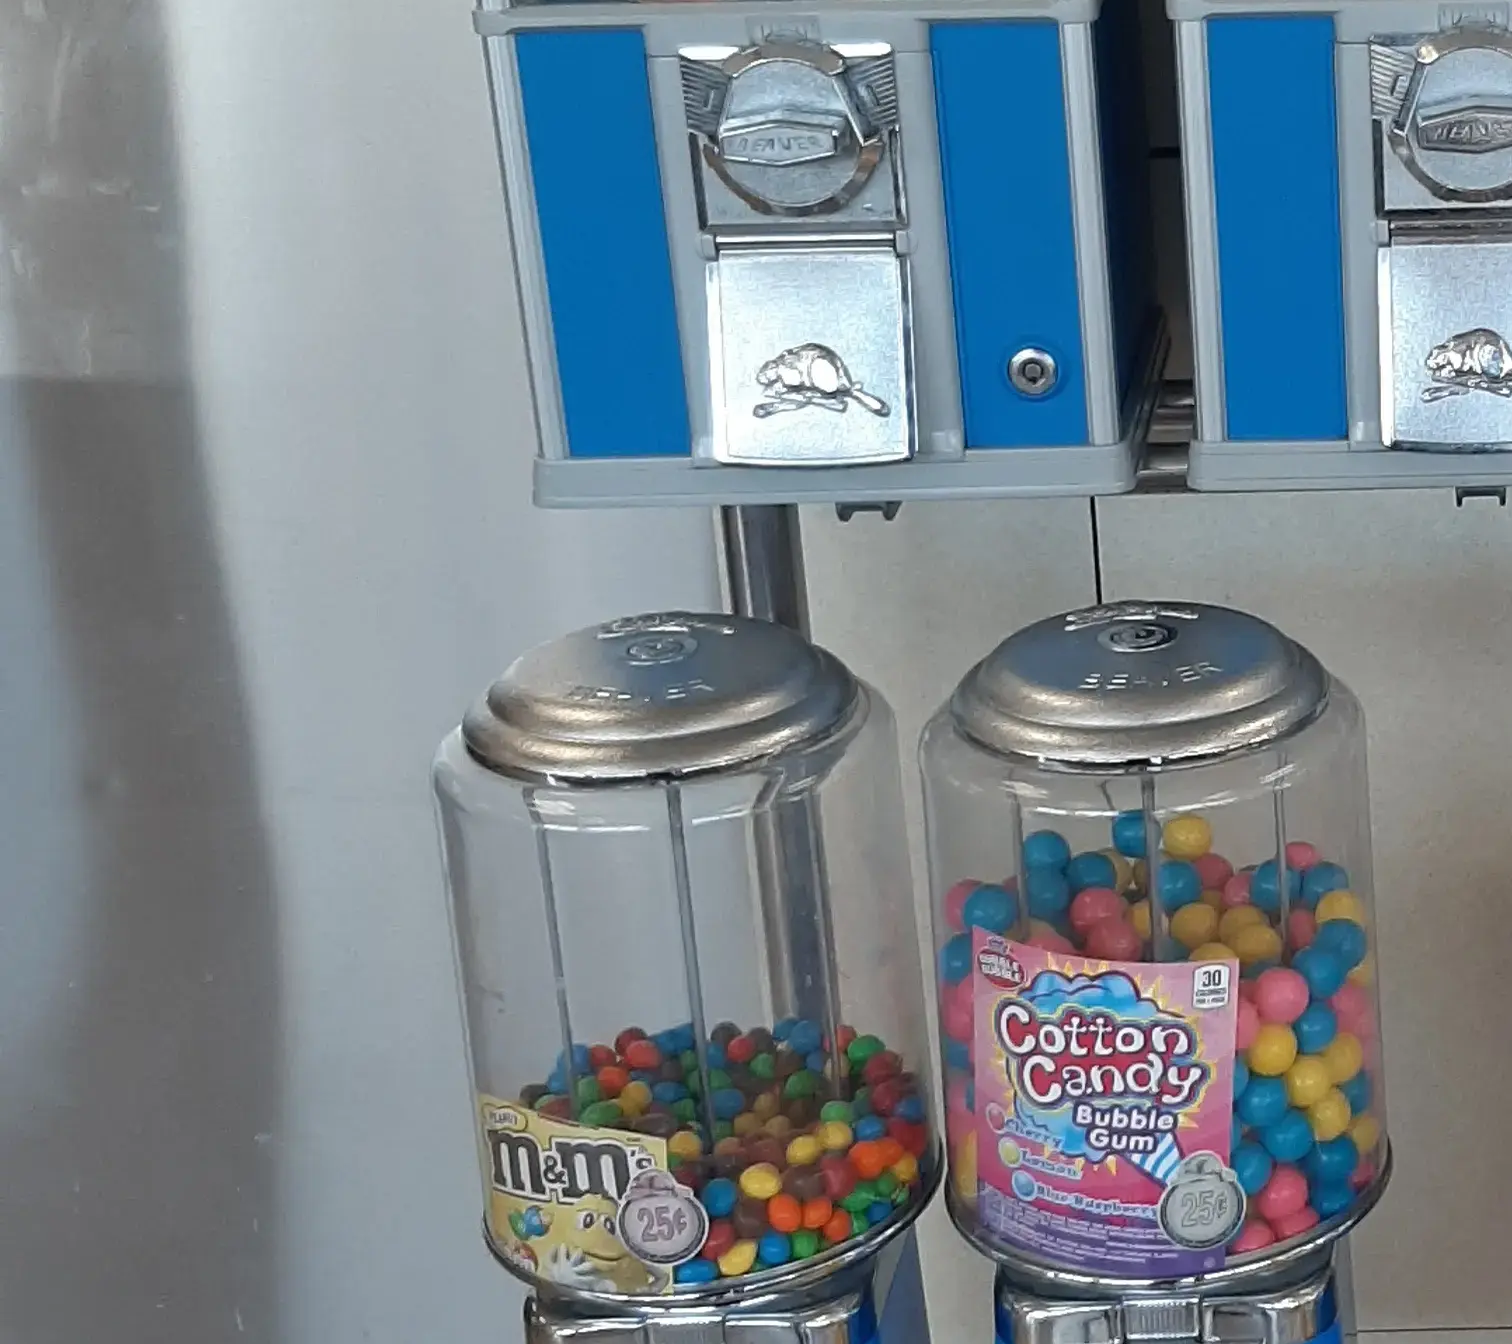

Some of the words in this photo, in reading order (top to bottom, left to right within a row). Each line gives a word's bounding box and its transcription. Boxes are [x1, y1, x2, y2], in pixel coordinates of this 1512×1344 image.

[1000, 1003, 1190, 1057] Cotton
[1022, 1053, 1203, 1105] Candy
[1075, 1104, 1175, 1130] Bubble
[1089, 1129, 1156, 1152] Gum
[637, 1205, 688, 1243] 25¢
[1180, 1189, 1229, 1228] 25¢
